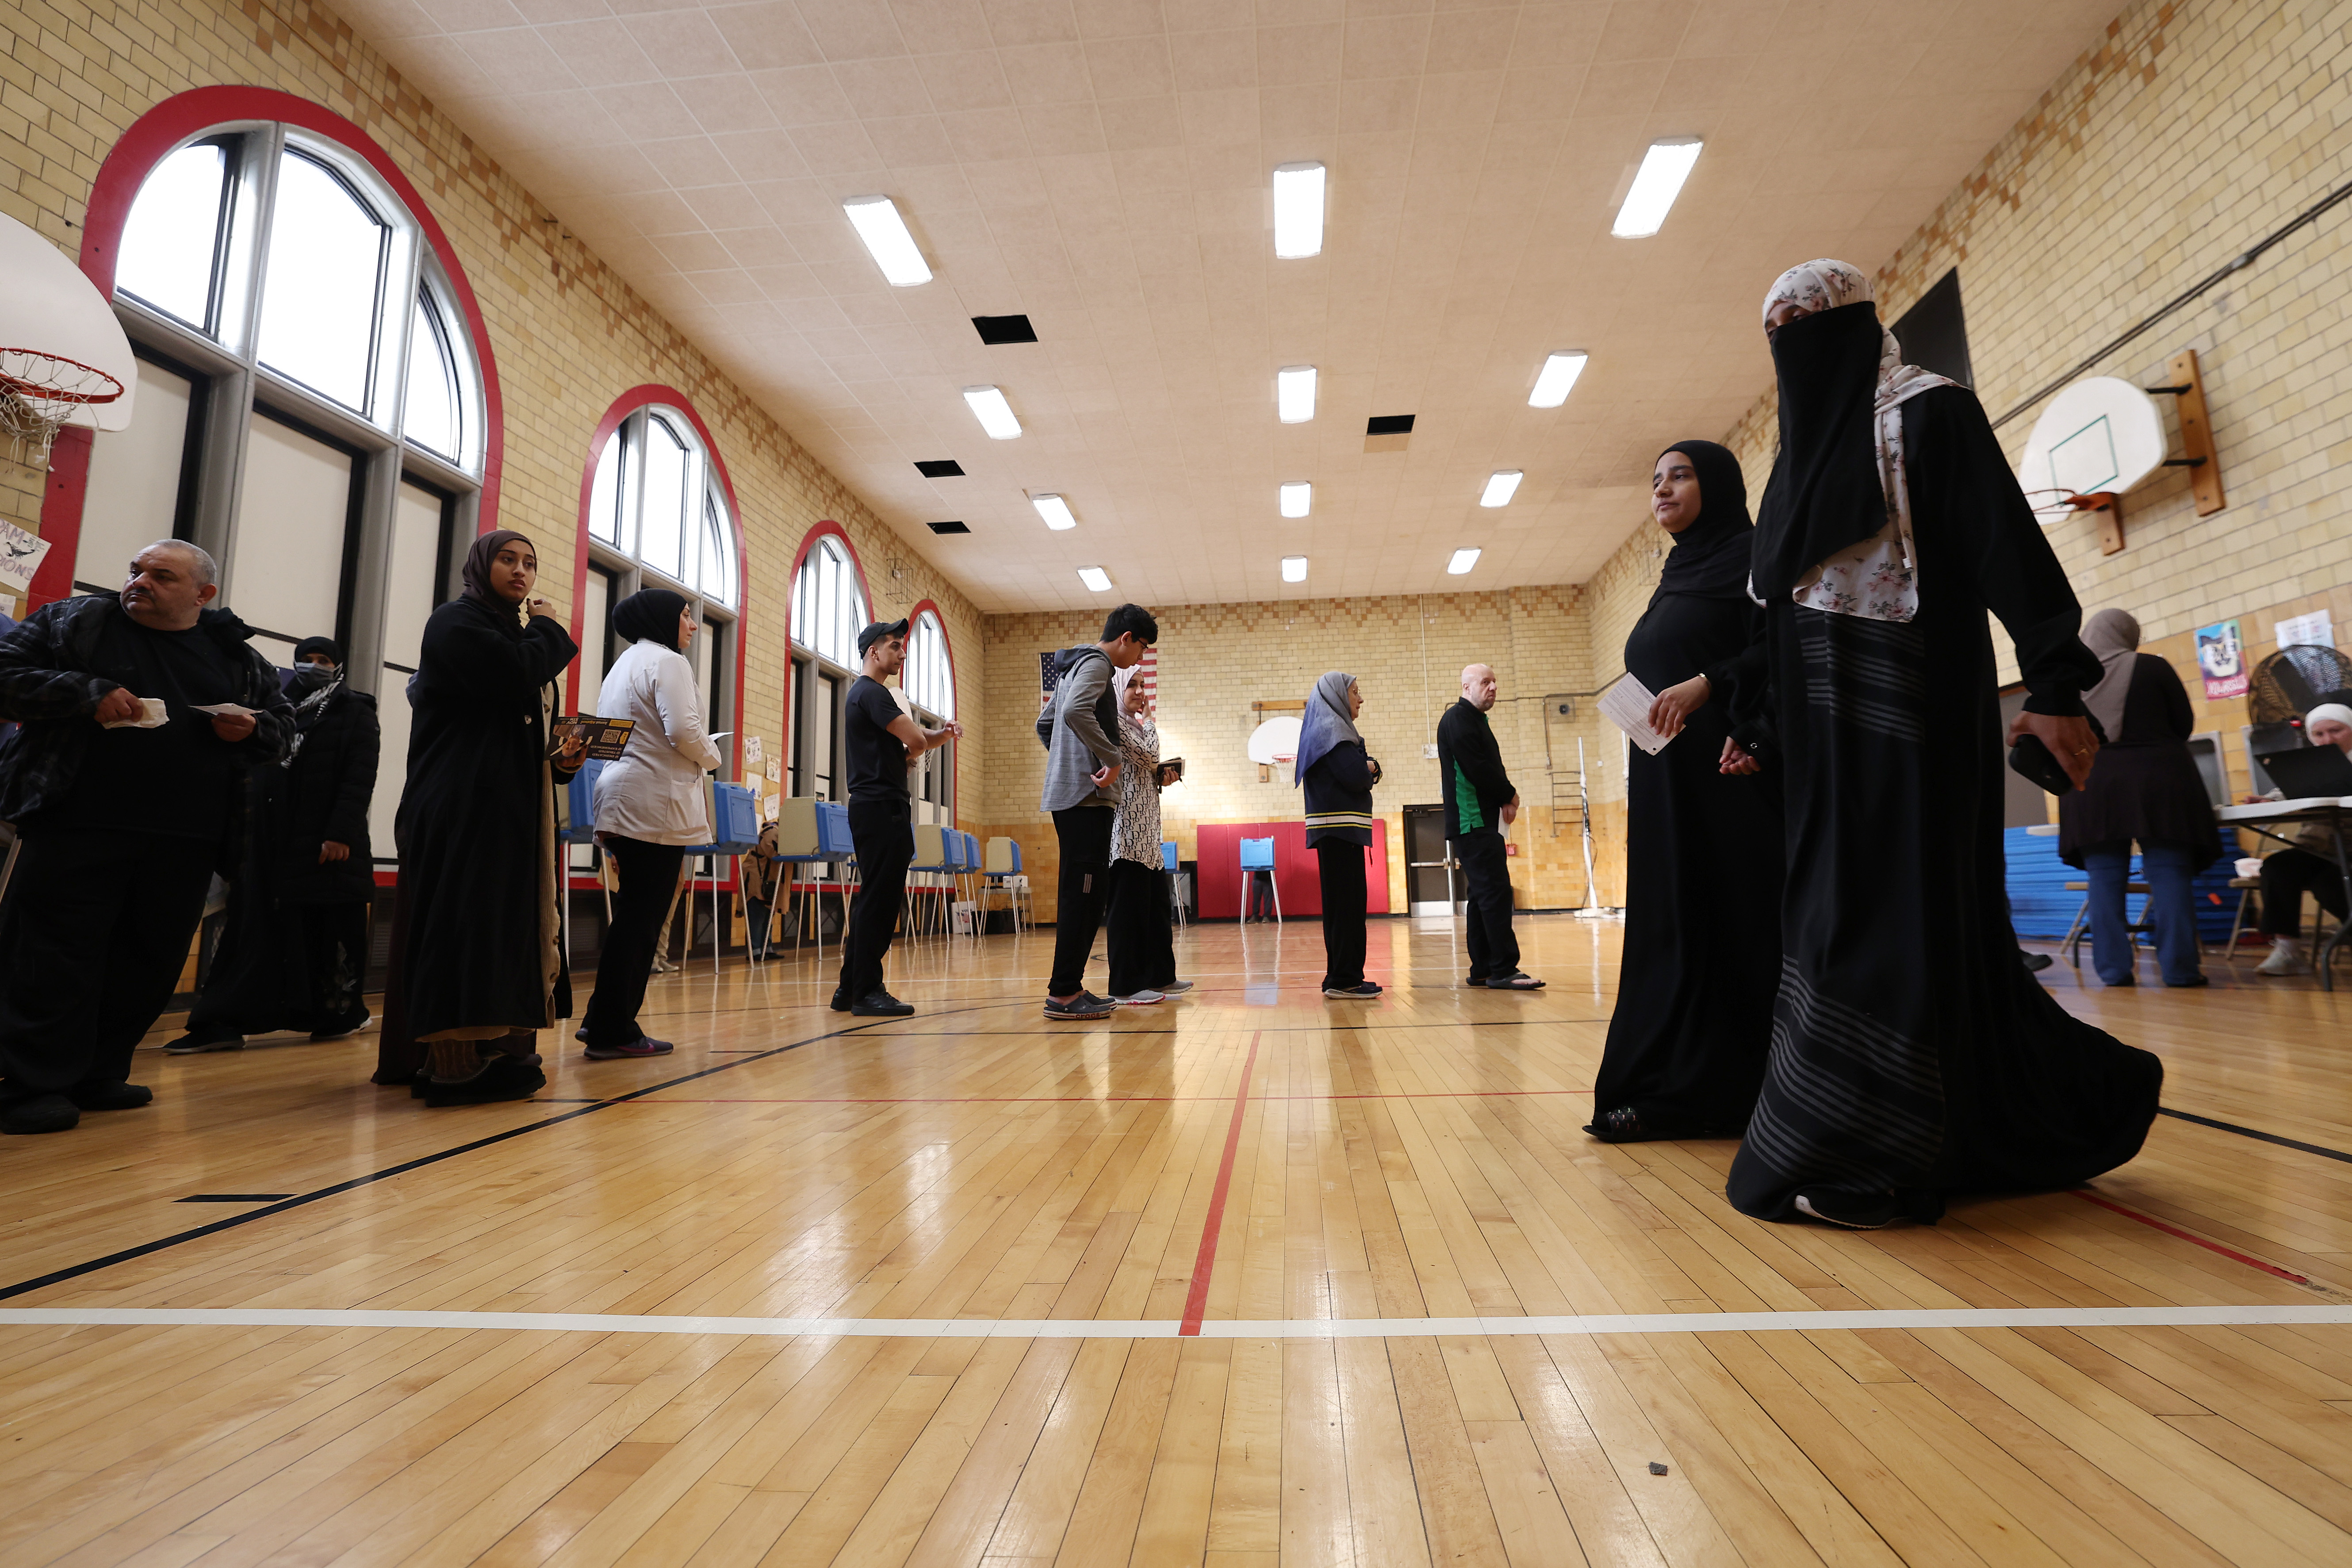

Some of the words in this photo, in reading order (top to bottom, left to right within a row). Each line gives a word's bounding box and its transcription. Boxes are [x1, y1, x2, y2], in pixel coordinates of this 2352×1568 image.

[1123, 772, 1134, 786] Dior
[1125, 791, 1137, 806] Dior
[1133, 784, 1143, 799] Dior
[1128, 811, 1139, 826] Dior
[1135, 804, 1146, 819] Dior
[1122, 819, 1134, 834] Dior
[1139, 824, 1148, 839] Dior
[1124, 839, 1136, 853] Dior
[1132, 831, 1142, 846] Dior
